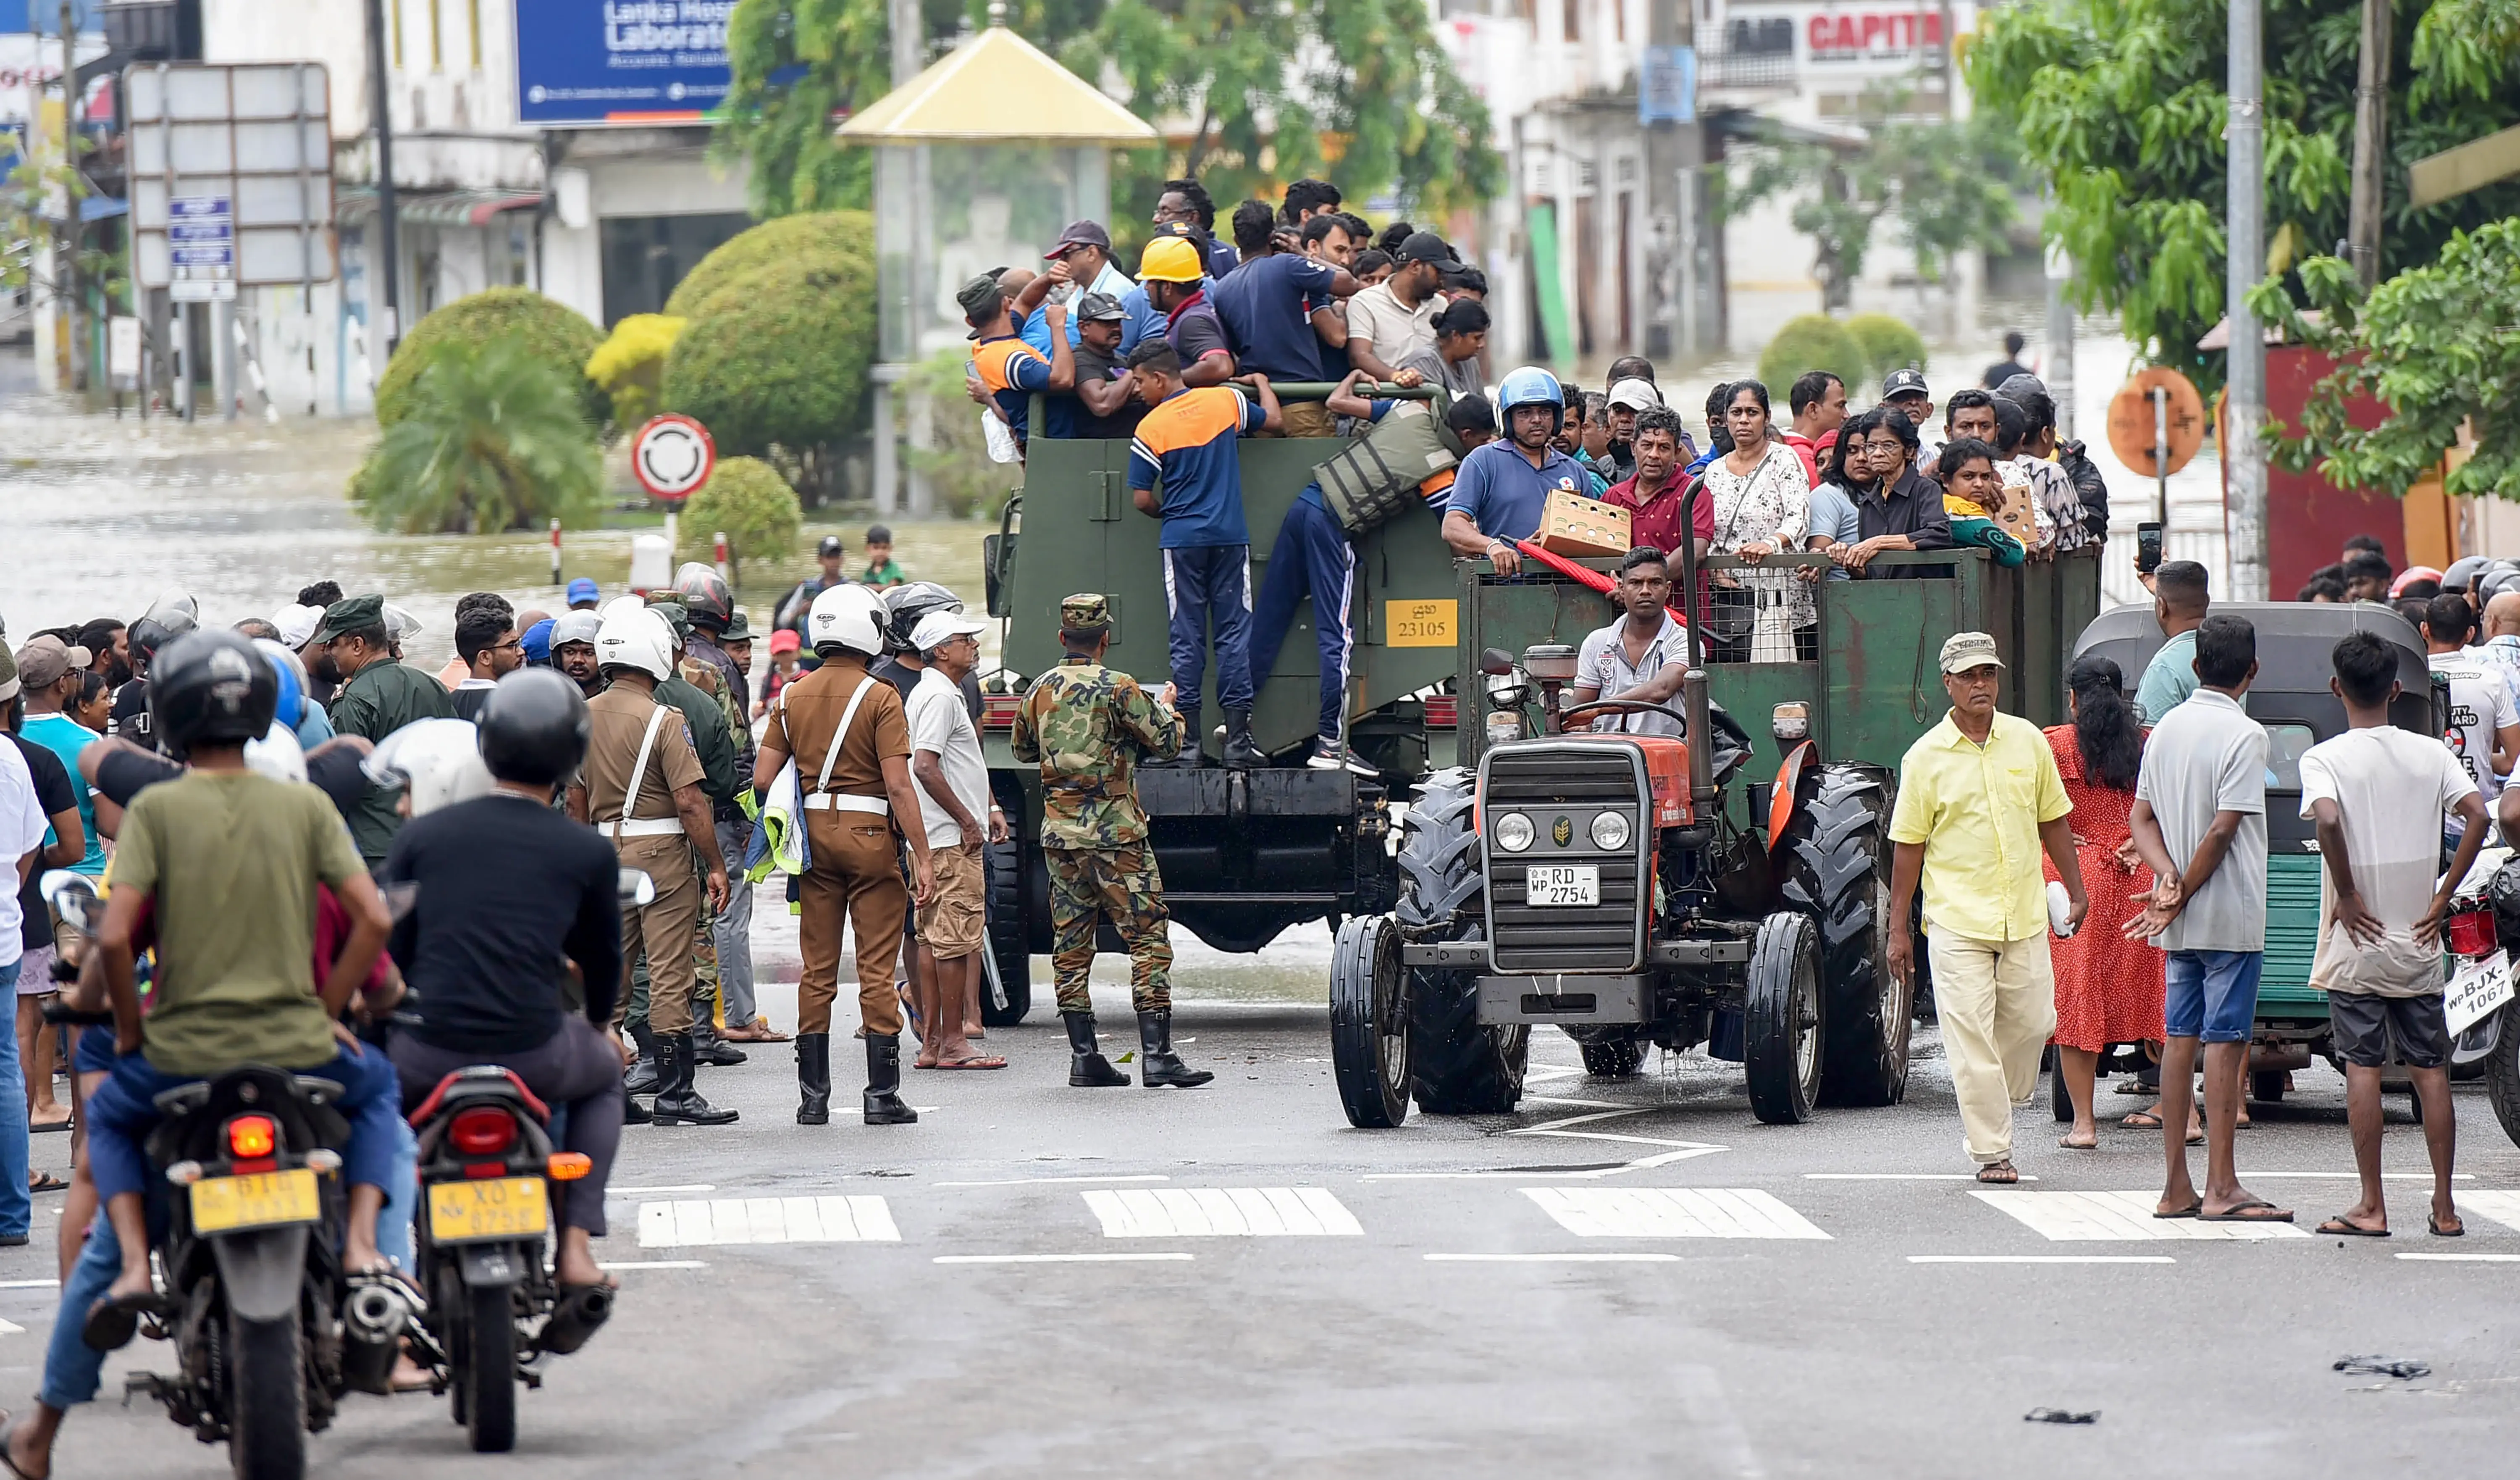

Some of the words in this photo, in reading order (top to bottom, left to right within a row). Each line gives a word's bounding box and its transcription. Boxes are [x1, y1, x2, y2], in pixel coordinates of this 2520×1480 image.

[604, 0, 678, 23] Lanka
[1399, 622, 1445, 636] 23105
[1552, 869, 1574, 884] RD
[1532, 880, 1547, 892] WP
[1551, 887, 1588, 903] 2754
[2448, 994, 2464, 1010] WP
[2467, 980, 2506, 1013] 1067
